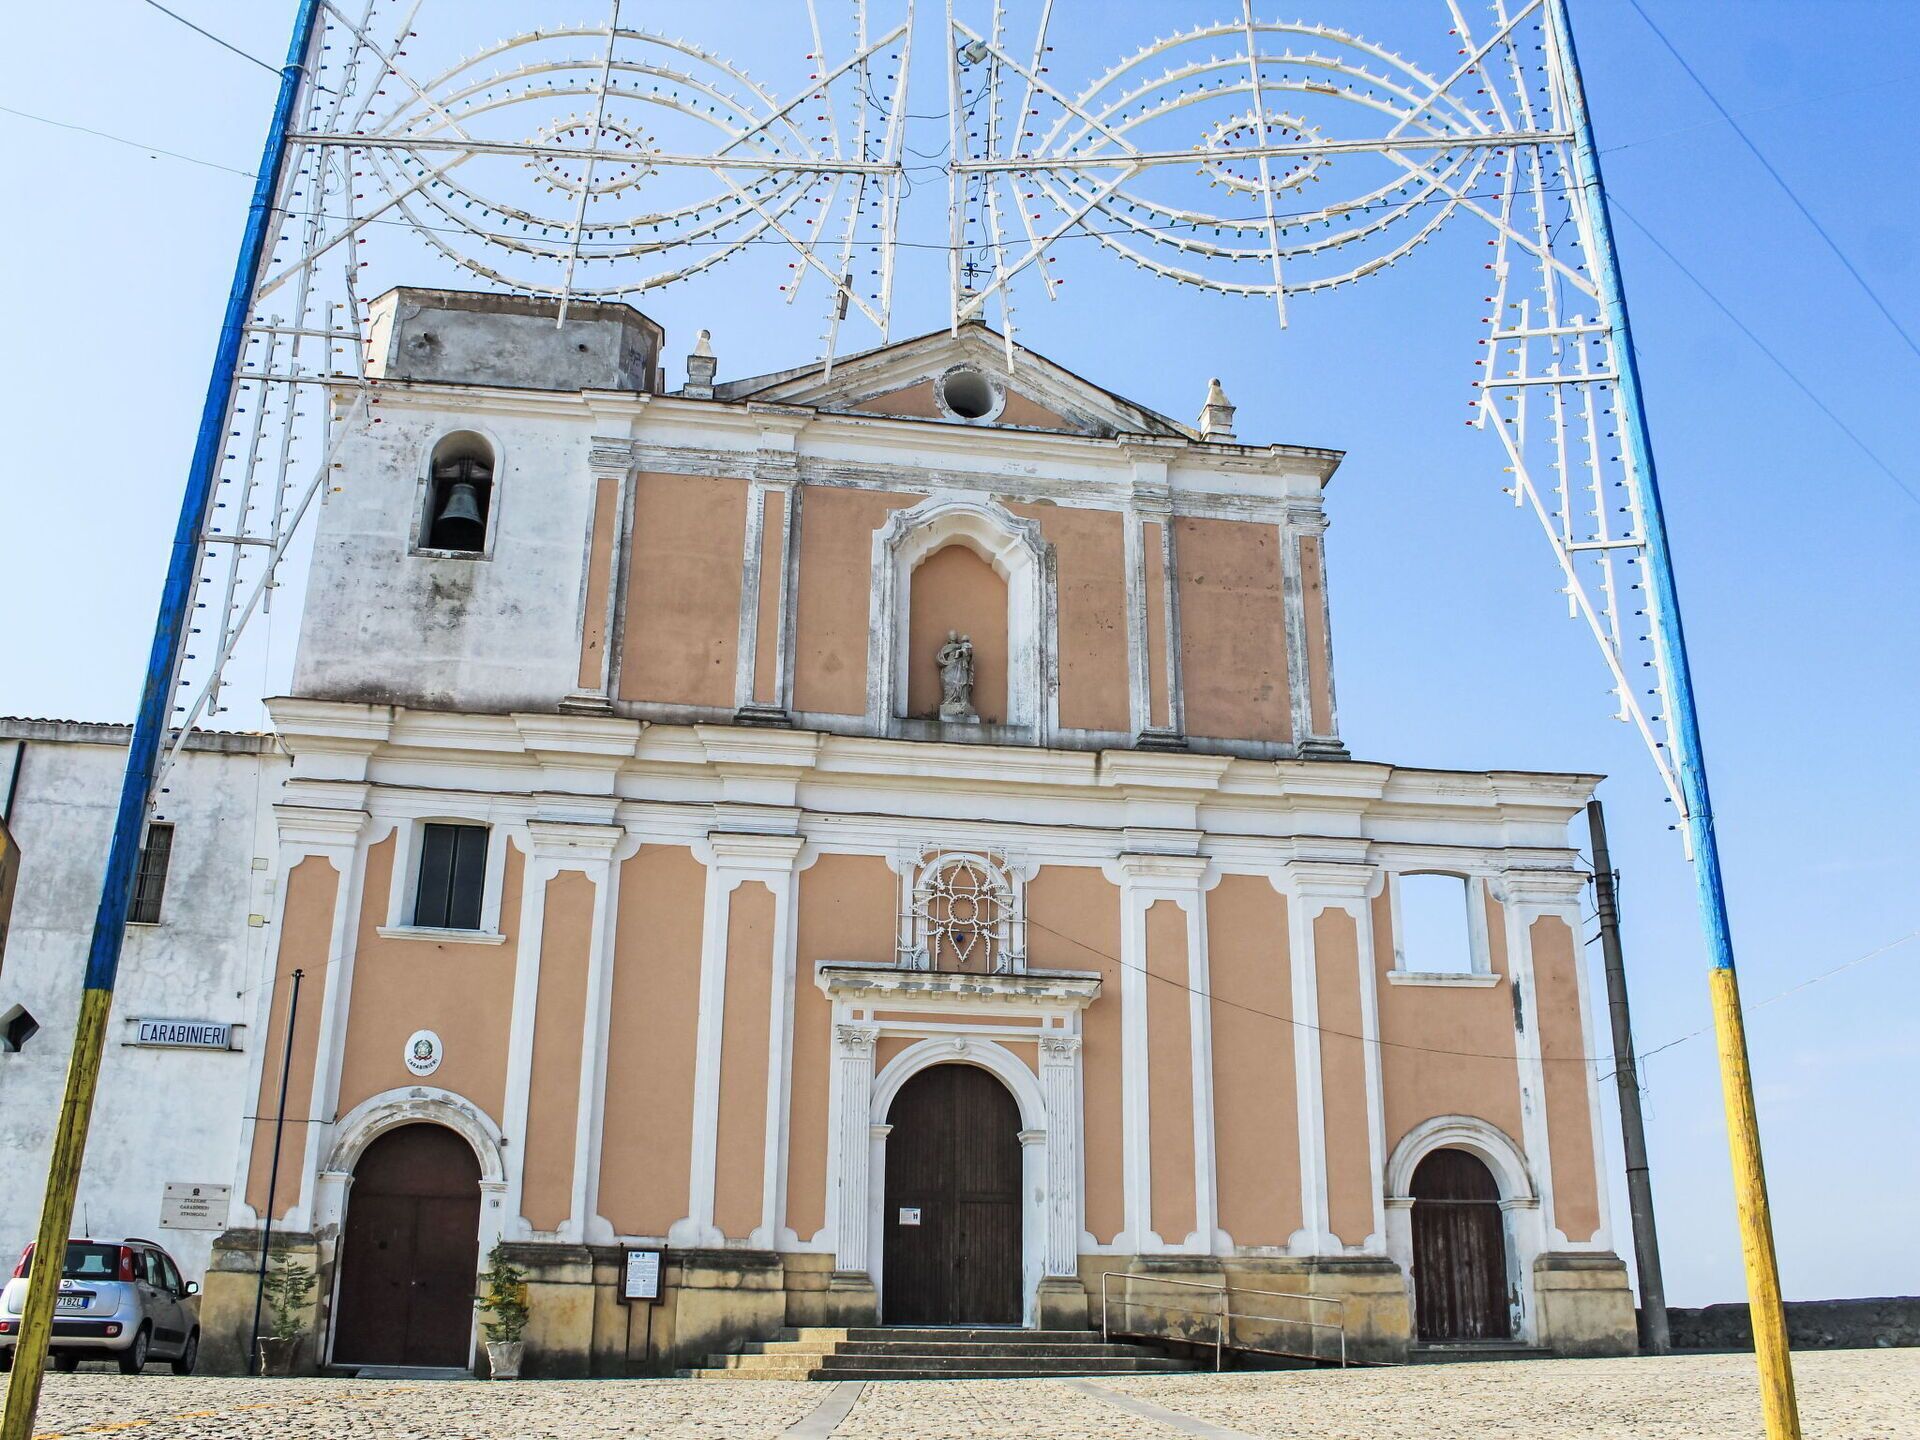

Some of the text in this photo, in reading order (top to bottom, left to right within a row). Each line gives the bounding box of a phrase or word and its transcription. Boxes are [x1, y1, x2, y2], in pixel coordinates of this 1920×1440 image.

[140, 1023, 226, 1044] CARABINIERI
[407, 1058, 438, 1070] CARABINIERI
[56, 1296, 80, 1307] 718ZL
